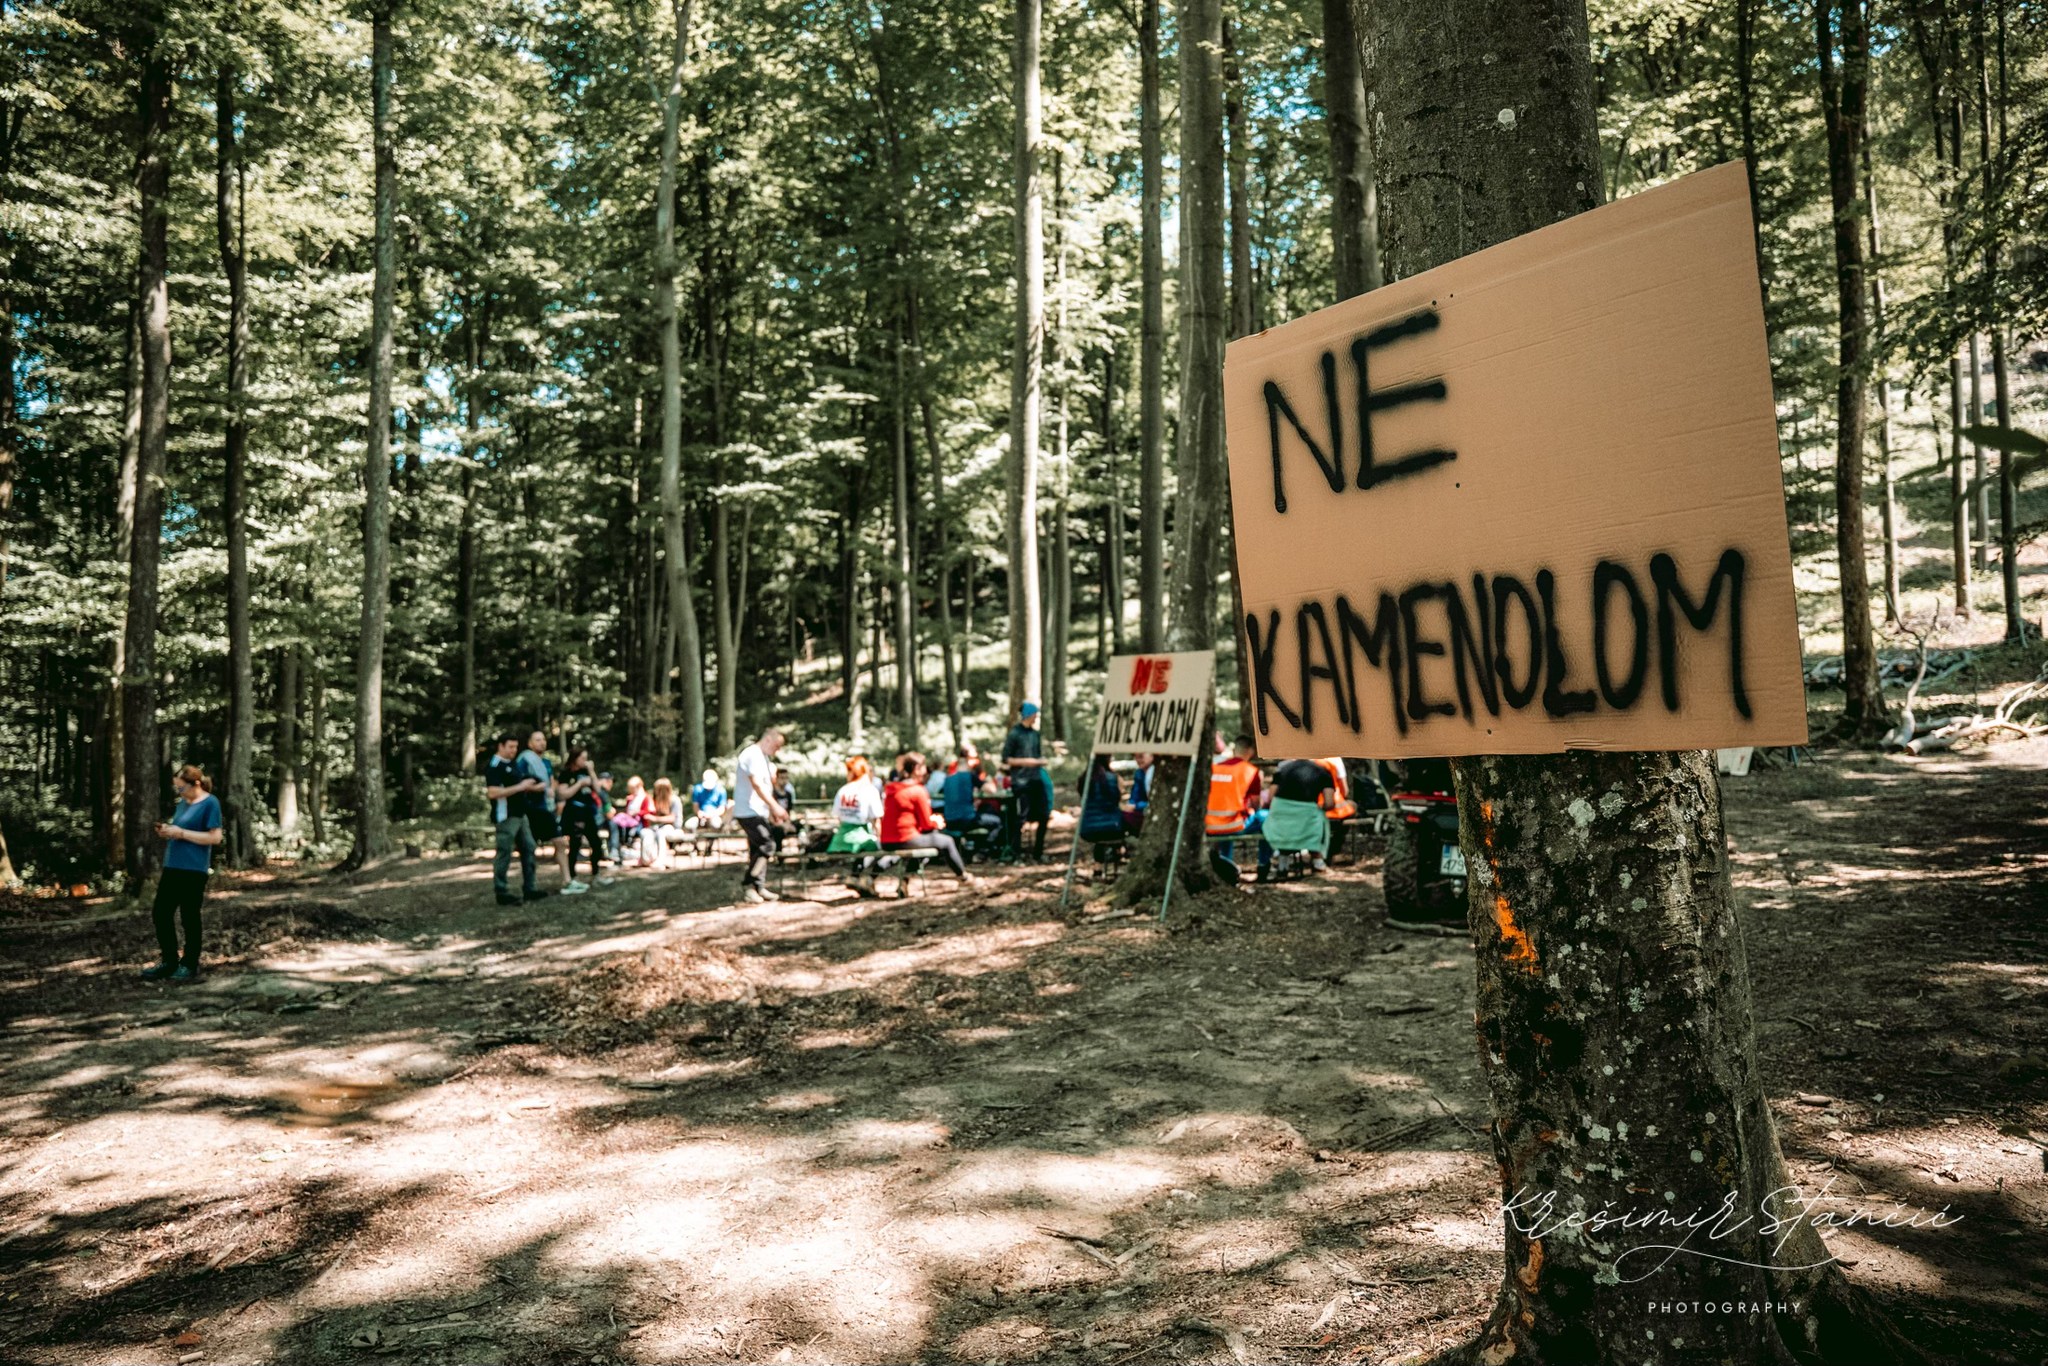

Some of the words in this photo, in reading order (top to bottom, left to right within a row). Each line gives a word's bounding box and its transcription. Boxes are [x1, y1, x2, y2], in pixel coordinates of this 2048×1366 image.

[1263, 309, 1457, 513] NE
[1130, 658, 1171, 696] NE
[1246, 549, 1753, 736] KAMENOLOM
